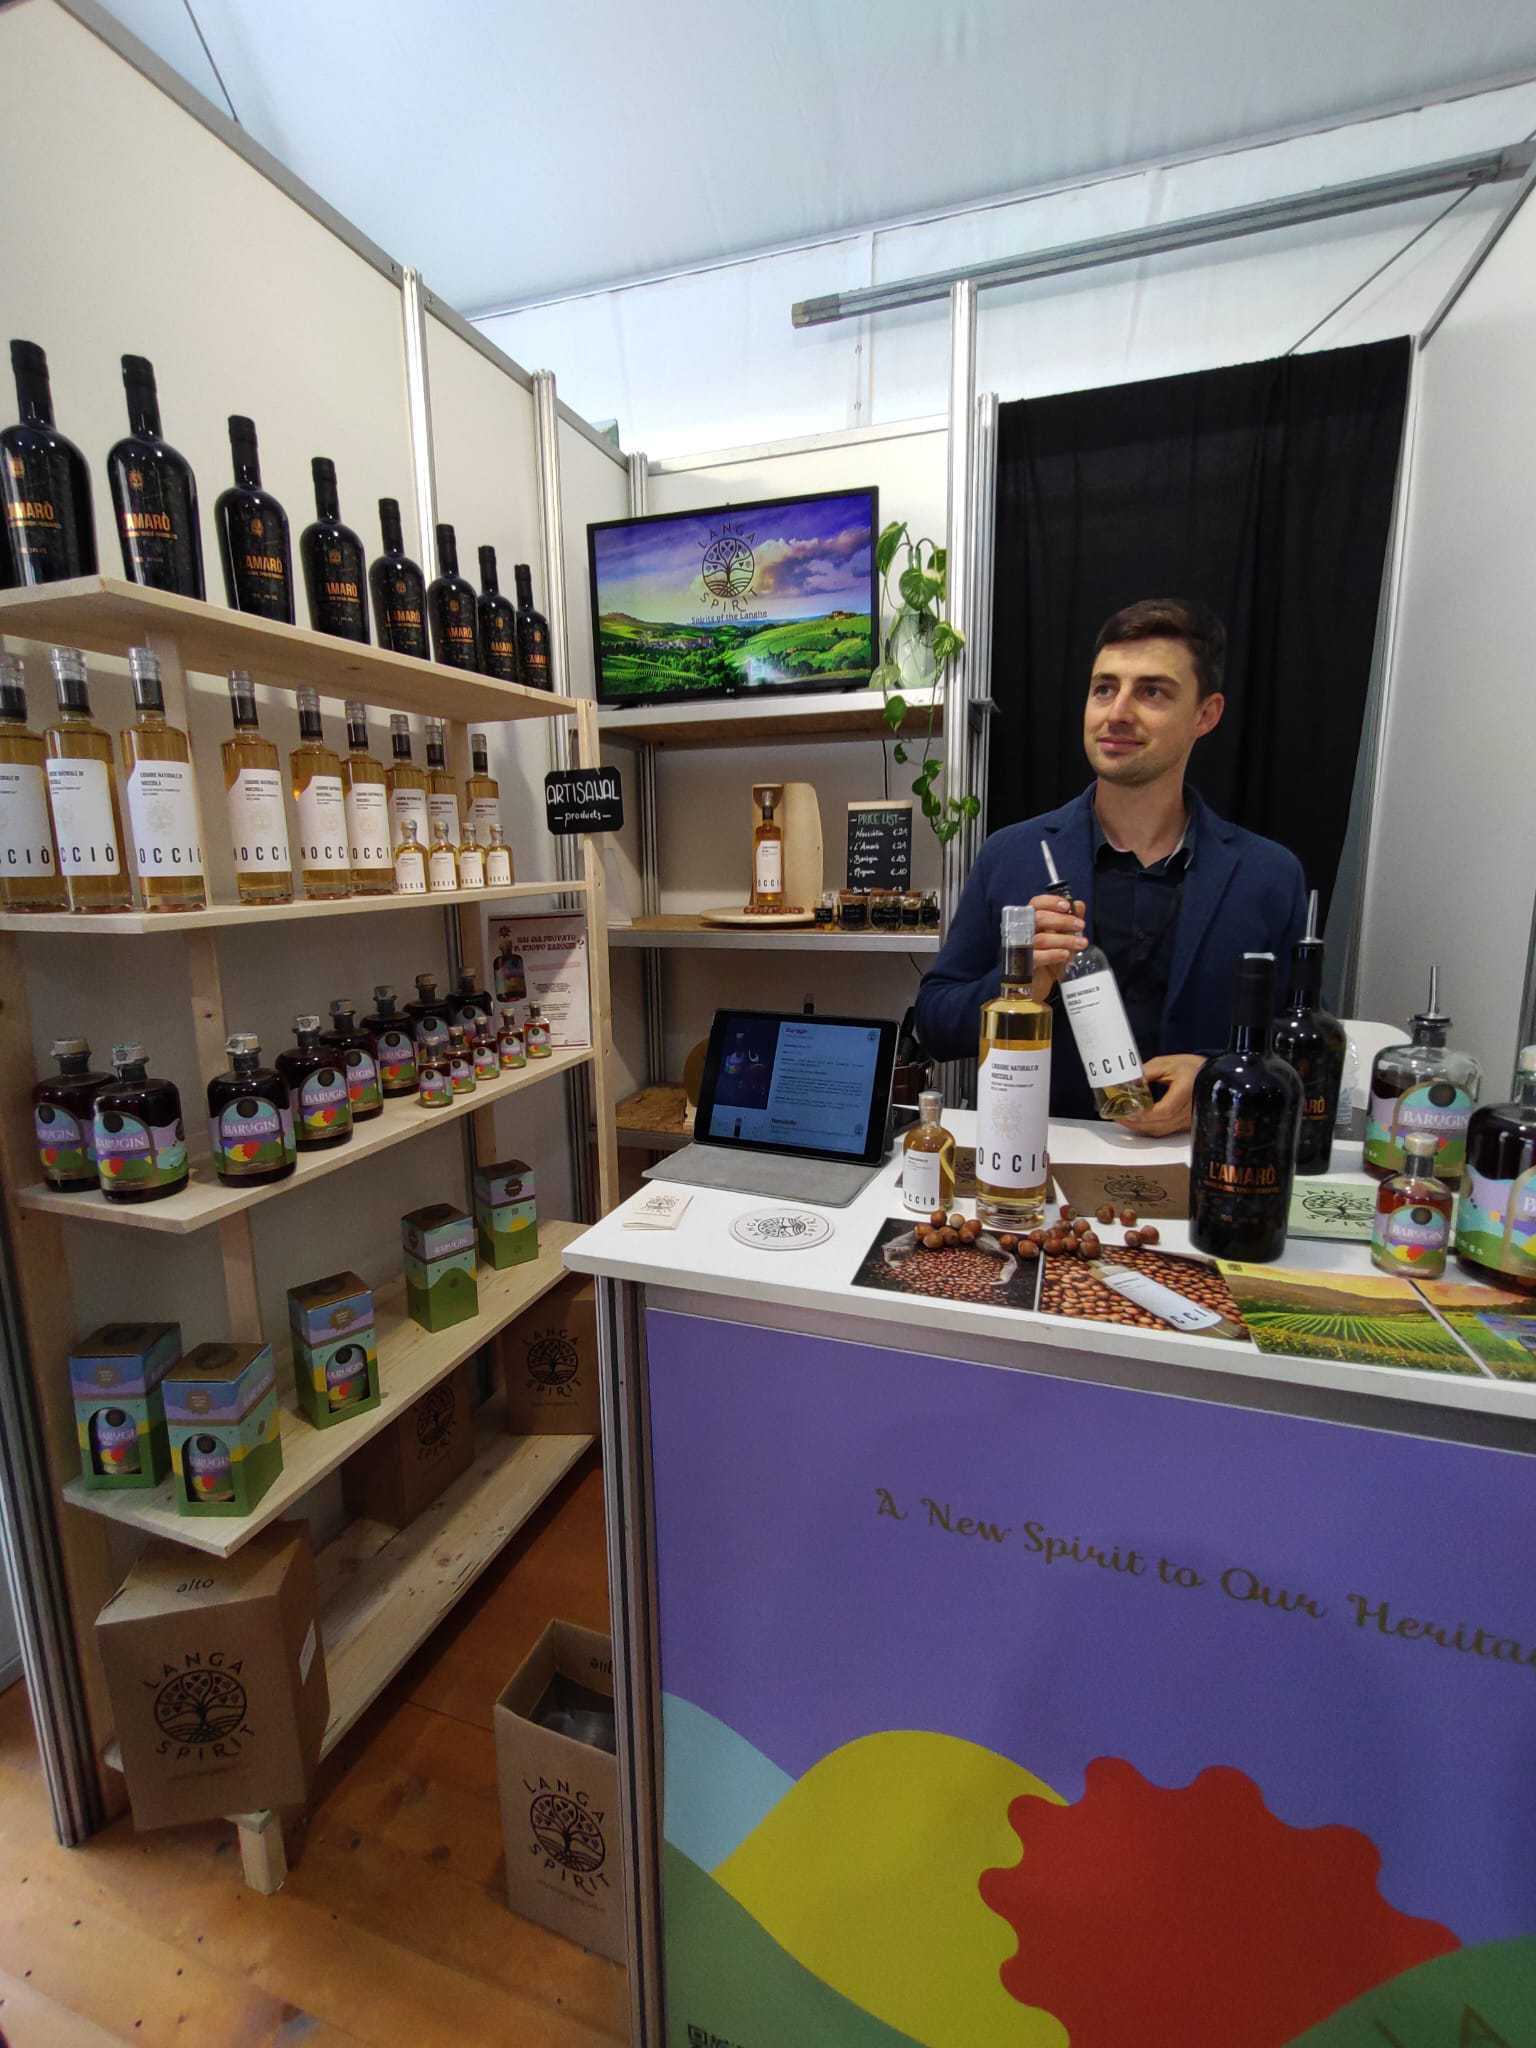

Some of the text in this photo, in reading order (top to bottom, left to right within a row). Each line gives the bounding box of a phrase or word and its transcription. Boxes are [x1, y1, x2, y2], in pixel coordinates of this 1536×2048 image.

[697, 522, 756, 550] LANGA
[699, 587, 759, 612] SPIRIT
[725, 611, 738, 620] the
[223, 1119, 277, 1137] BARUGIN
[875, 1487, 909, 1521] A
[920, 1497, 1013, 1544] New
[1023, 1520, 1146, 1576] Spirit
[1156, 1556, 1208, 1588] to
[1220, 1567, 1329, 1619] Our
[176, 1577, 215, 1594] alto
[142, 1652, 244, 1689] LANGA
[155, 1723, 255, 1761] SPIRIT
[522, 1775, 605, 1824] LANGA
[527, 1842, 611, 1897] SPIRIT
